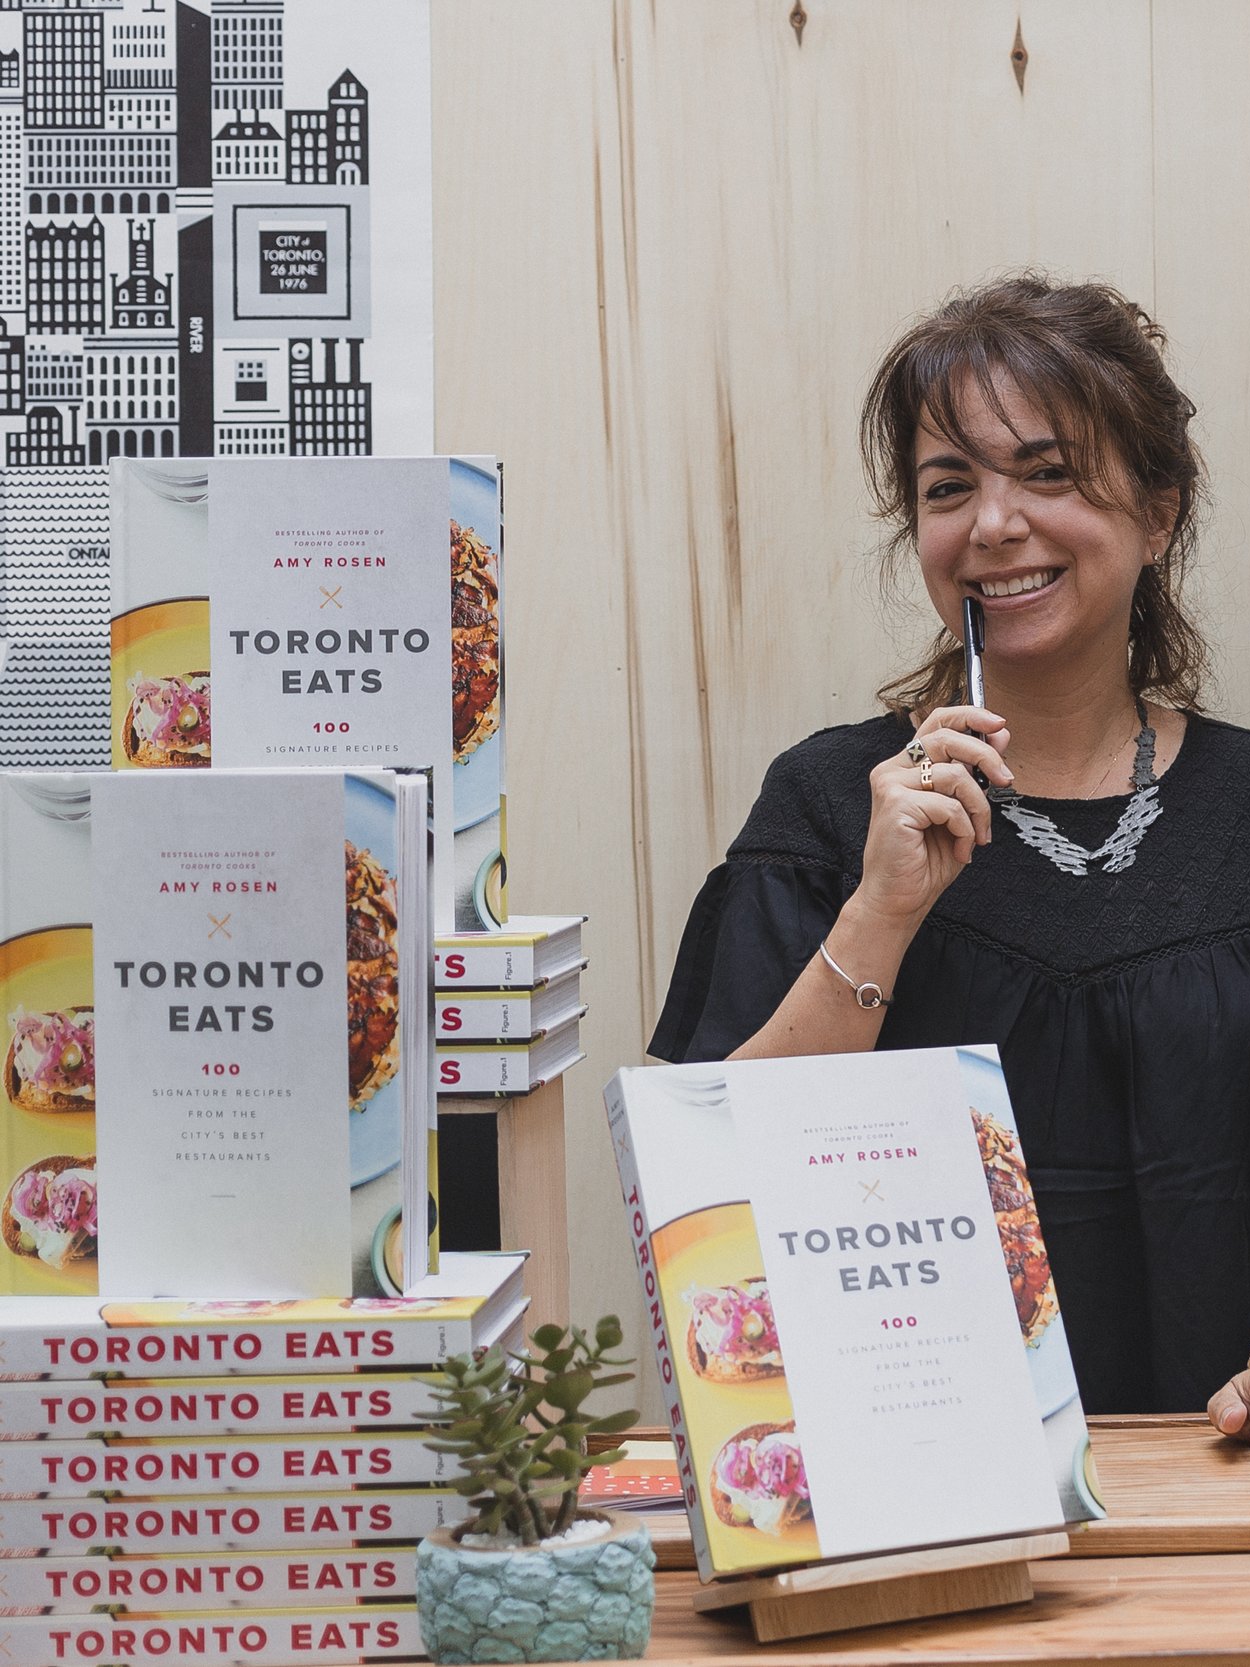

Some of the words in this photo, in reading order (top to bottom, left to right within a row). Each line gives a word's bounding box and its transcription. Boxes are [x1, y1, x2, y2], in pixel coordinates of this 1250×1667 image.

[276, 236, 300, 247] CITY
[271, 264, 286, 276] 26
[288, 264, 318, 276] JUNE
[280, 279, 308, 290] 1976
[189, 316, 203, 353] RIVER
[274, 558, 312, 568] AMY
[324, 557, 386, 567] ROSEN
[230, 628, 430, 654] TORONTO
[282, 669, 382, 694] EATS
[312, 722, 350, 733] 100
[266, 746, 338, 754] SIGNATURE
[346, 744, 399, 752] RECIPES
[160, 882, 200, 893] AMY
[213, 881, 278, 892] ROSEN
[114, 960, 324, 988] TORONTO
[168, 1005, 275, 1033] EATS
[202, 1064, 241, 1076] 100
[152, 1088, 230, 1098] SIGNATURE
[236, 1088, 292, 1098] RECIPES
[188, 1110, 224, 1119] FROM
[232, 1110, 257, 1119] THE
[181, 1131, 227, 1140] CITY'S
[234, 1131, 266, 1140] BEST
[176, 1152, 271, 1162] RESTAURANTS
[808, 1154, 845, 1165] AMY
[858, 1148, 918, 1161] ROSEN
[778, 1216, 976, 1256] TORONTO
[839, 1260, 940, 1292] EATS
[881, 1316, 917, 1330] 100
[44, 1333, 262, 1364] TORONTO
[286, 1330, 395, 1358] EATS
[628, 1184, 672, 1384] TORONTO
[671, 1403, 696, 1508] EATS
[838, 1341, 910, 1355] SIGNATURE
[918, 1334, 970, 1346] RECIPES
[876, 1361, 910, 1371] FROM
[919, 1358, 941, 1366] THE
[923, 1377, 952, 1387] BEST
[41, 1393, 259, 1424] TORONTO
[283, 1390, 392, 1418] EATS
[872, 1397, 962, 1412] RESTAURANTS
[42, 1451, 260, 1482] TORONTO
[283, 1448, 392, 1476] EATS
[42, 1508, 260, 1540] TORONTO
[284, 1504, 392, 1532] EATS
[46, 1565, 264, 1597] TORONTO
[288, 1561, 396, 1589] EATS
[50, 1625, 267, 1658] TORONTO
[291, 1621, 400, 1650] EATS
